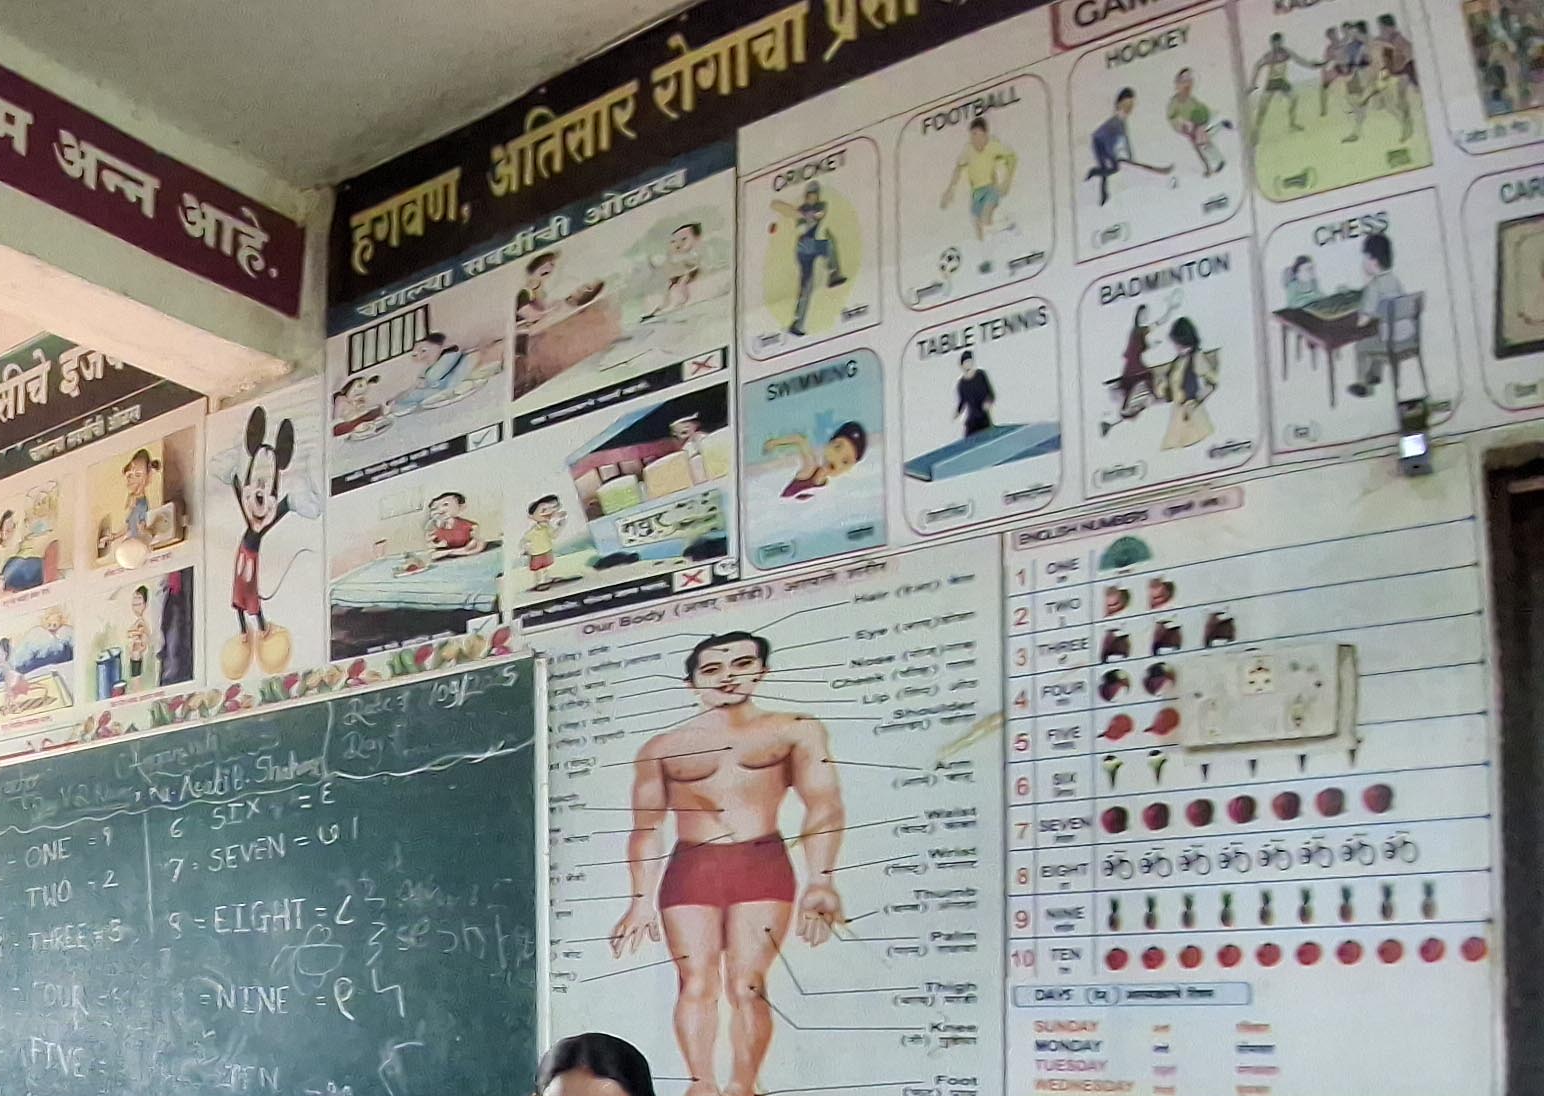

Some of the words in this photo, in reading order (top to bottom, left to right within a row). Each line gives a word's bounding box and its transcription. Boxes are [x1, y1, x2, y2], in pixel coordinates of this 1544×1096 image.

[1104, 25, 1191, 69] HOCKEY
[487, 79, 639, 199] अतिसार
[652, 3, 807, 117] रोगाचा
[921, 86, 1021, 136] FOOTBALL
[772, 148, 849, 193] CRICKET
[53, 130, 160, 218] अन्न
[179, 191, 280, 282] आहे.
[1312, 210, 1391, 247] CHESS
[1100, 252, 1231, 306] BADMINTON
[916, 326, 975, 360] TABLE
[980, 305, 1049, 342] TENNIS
[766, 359, 859, 402] SWIMMING
[583, 617, 615, 635] Our
[619, 607, 666, 628] Body
[210, 799, 260, 830] SIX
[24, 837, 72, 870] ONE
[209, 834, 286, 872] SEVEN
[26, 880, 73, 908] TWO
[213, 899, 307, 934] EIGHT
